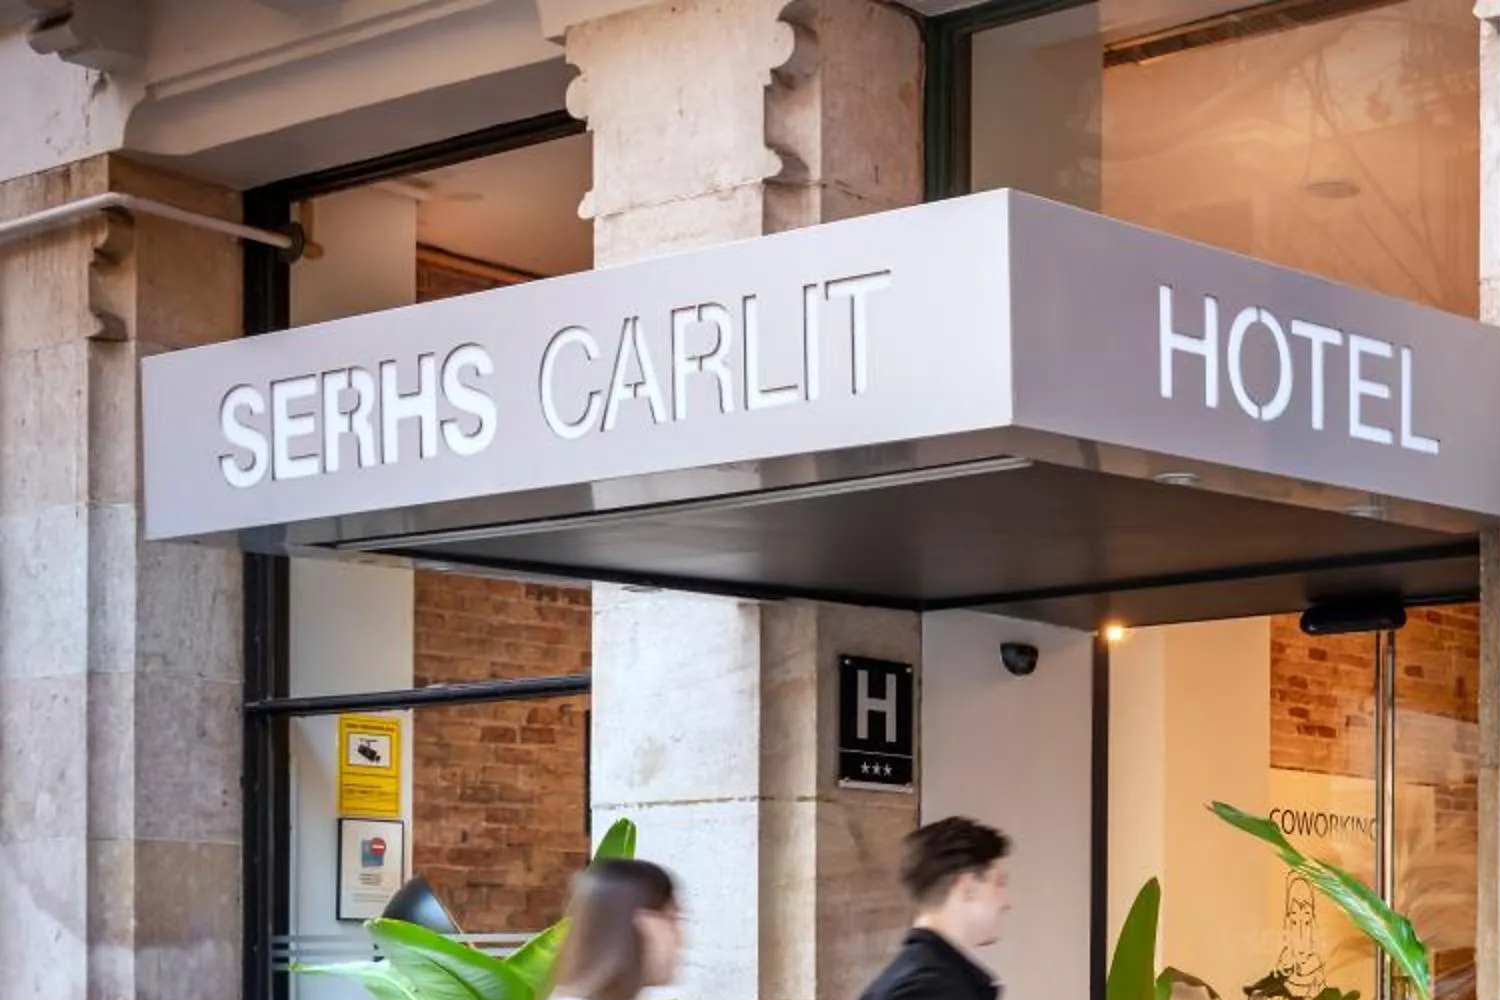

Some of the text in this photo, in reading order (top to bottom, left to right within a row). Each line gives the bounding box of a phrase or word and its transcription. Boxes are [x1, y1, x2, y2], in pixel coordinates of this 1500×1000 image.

[217, 269, 892, 488] SERHS CARLIT
[1159, 284, 1440, 455] HOTEL
[857, 669, 897, 742] H
